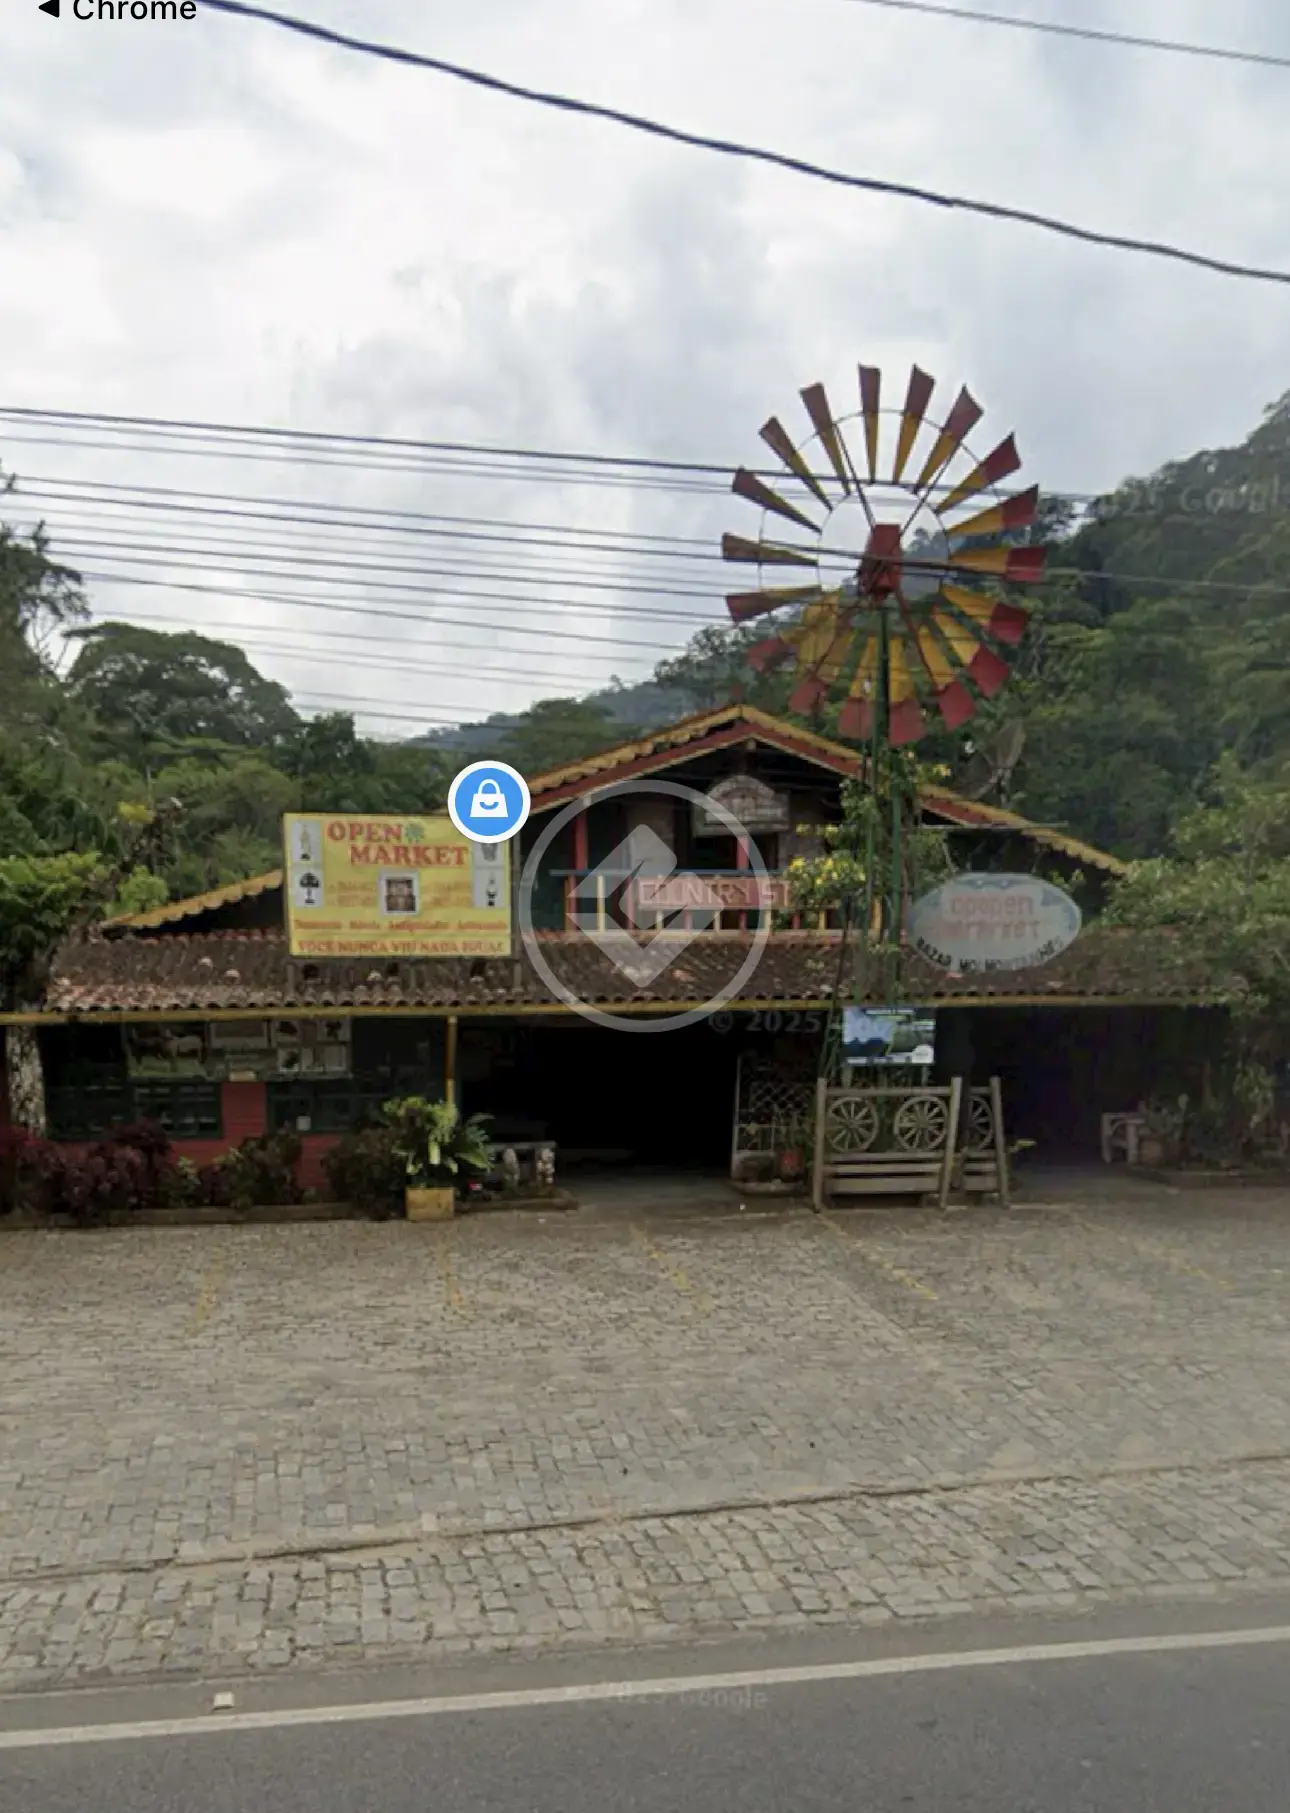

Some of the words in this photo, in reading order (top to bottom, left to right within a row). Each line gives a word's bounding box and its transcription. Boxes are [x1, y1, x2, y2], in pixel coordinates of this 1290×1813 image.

[326, 820, 404, 843] OPEN
[350, 845, 469, 866] MARKET
[338, 940, 388, 954] NUNCA
[420, 940, 459, 954] NADA
